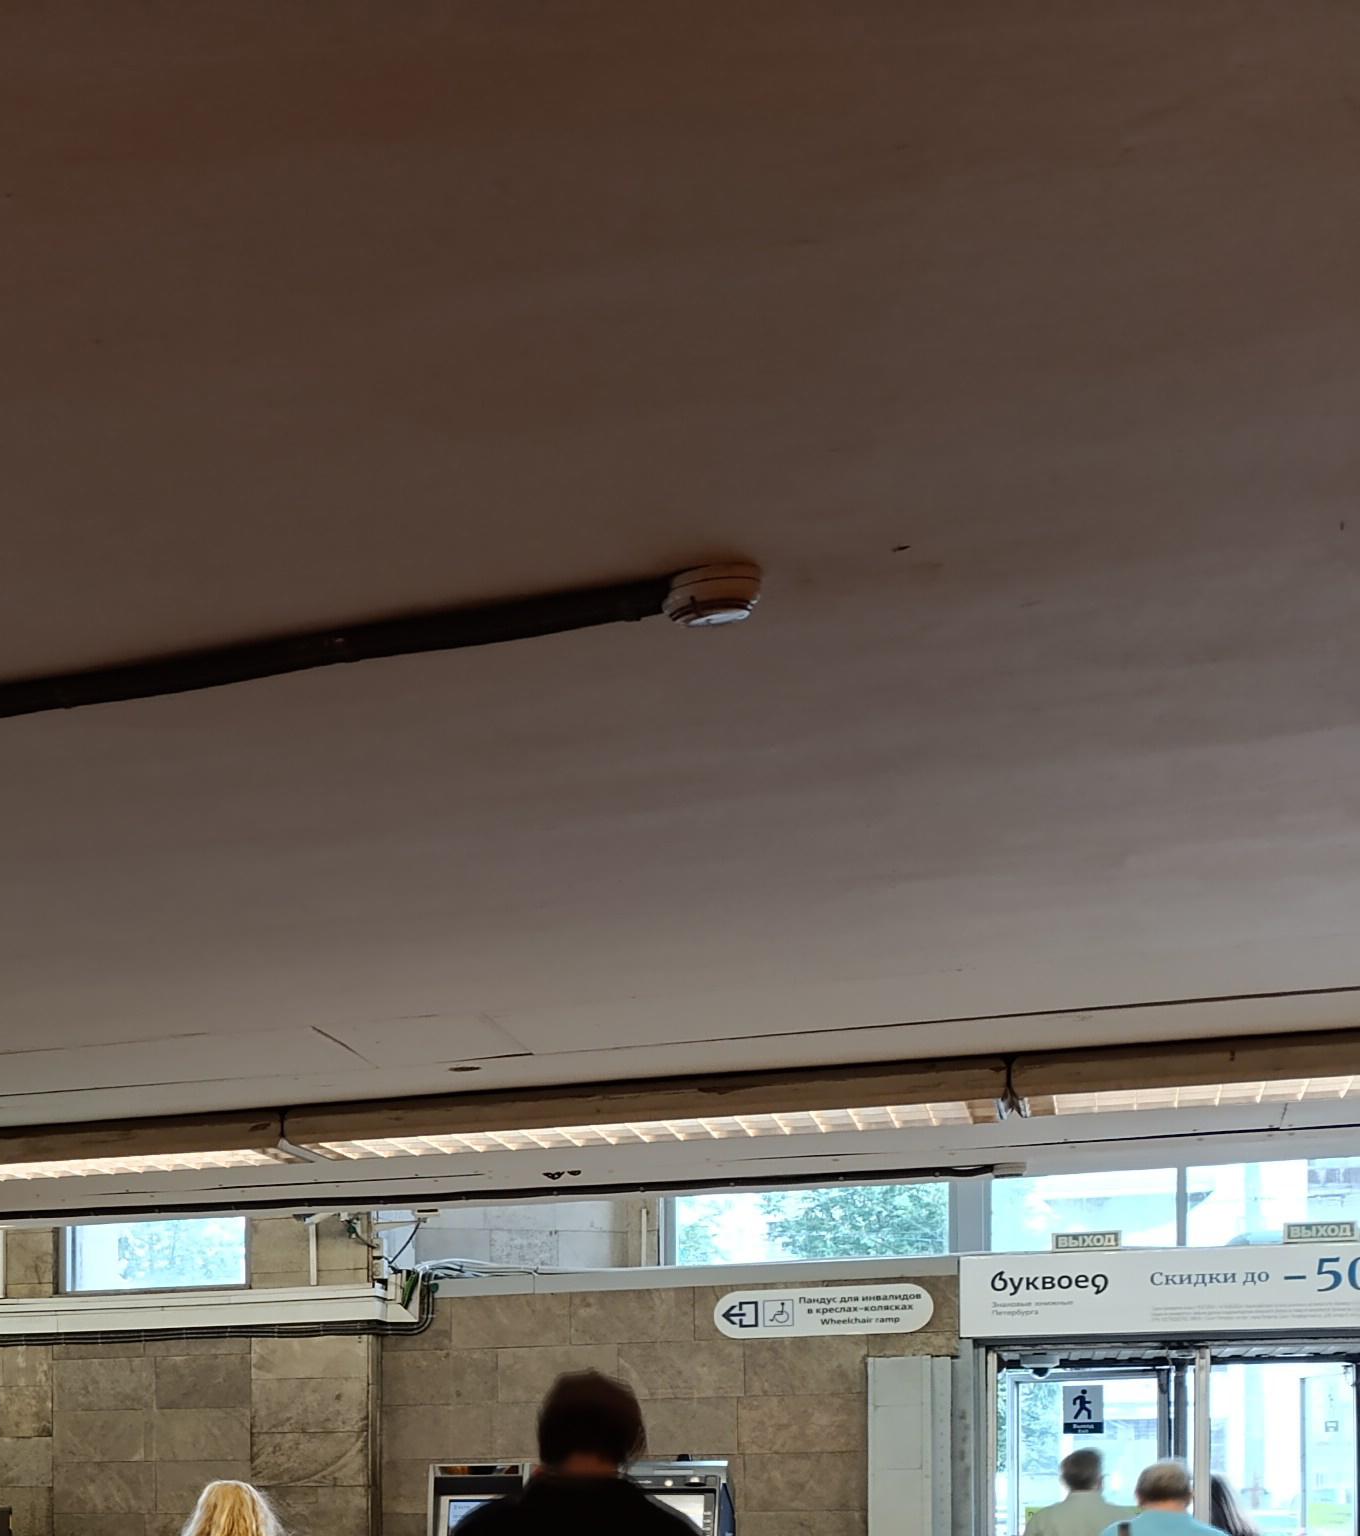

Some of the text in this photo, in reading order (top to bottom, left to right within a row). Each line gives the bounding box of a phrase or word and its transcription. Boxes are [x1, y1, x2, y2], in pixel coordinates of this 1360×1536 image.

[1290, 1223, 1352, 1239] ВЫХОД
[1057, 1233, 1117, 1249] ВЫХОД
[991, 1271, 1109, 1297] буквоед
[1150, 1271, 1237, 1288] Скидки
[1242, 1271, 1270, 1287] до
[799, 1292, 922, 1305] Пандус для инвалидов
[820, 1316, 873, 1326] Wheelchair
